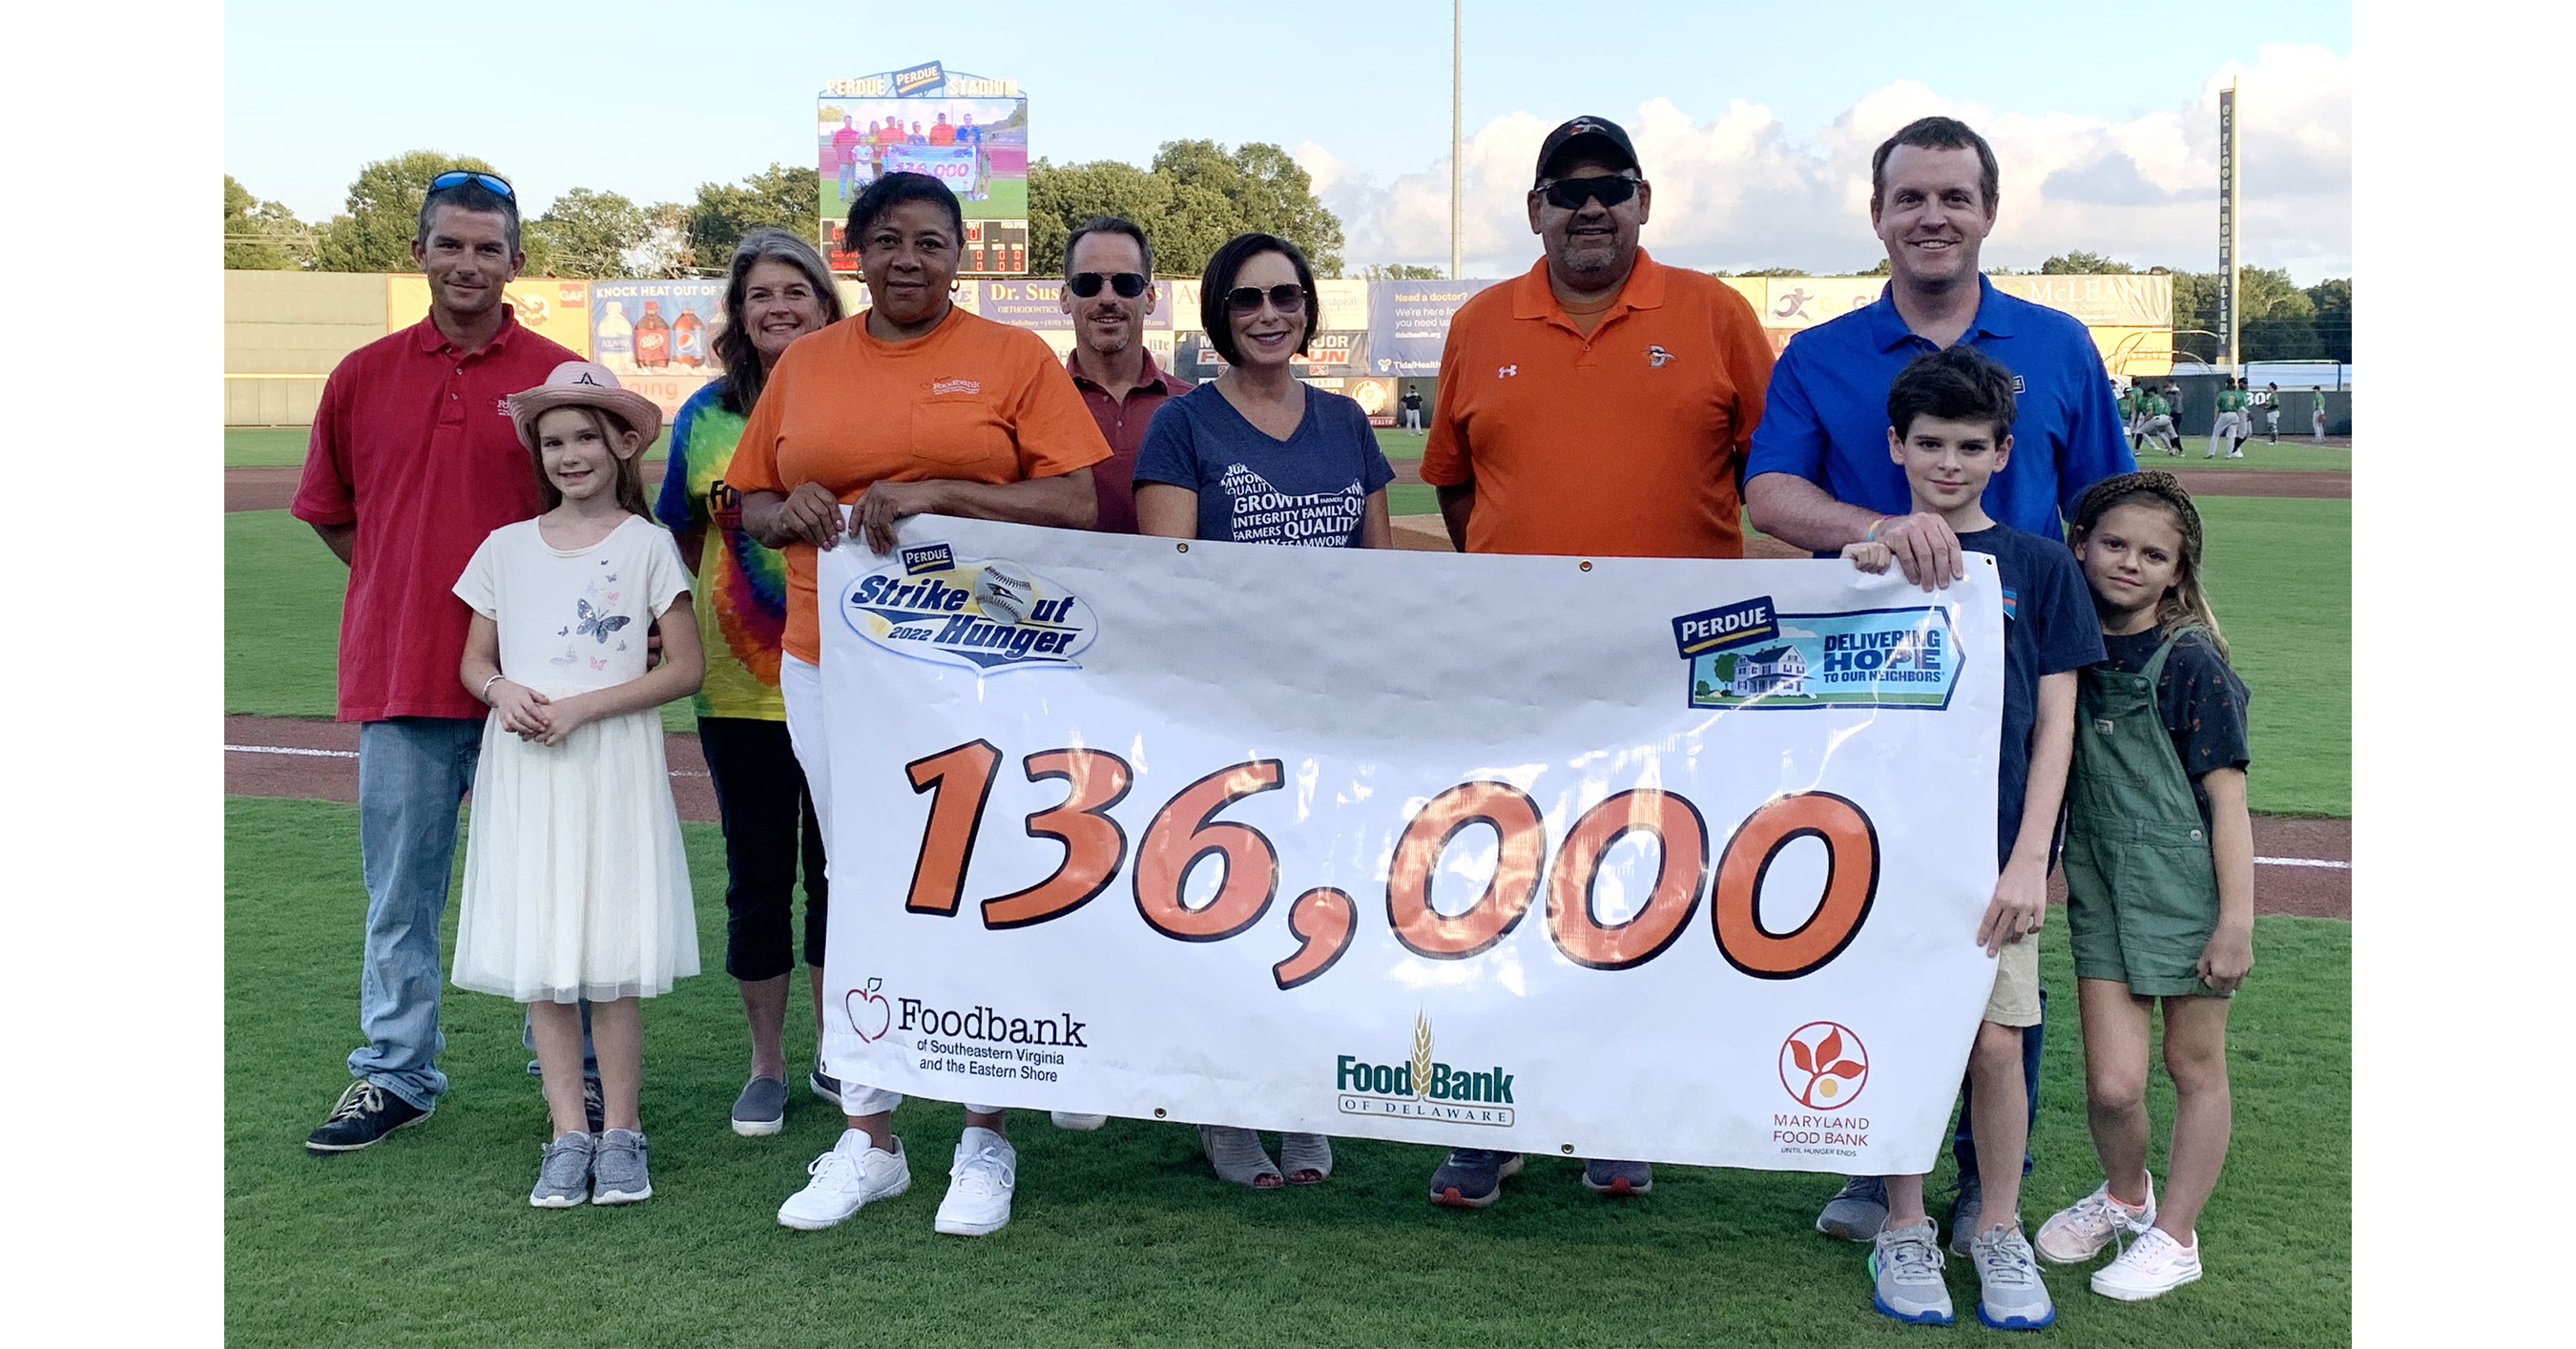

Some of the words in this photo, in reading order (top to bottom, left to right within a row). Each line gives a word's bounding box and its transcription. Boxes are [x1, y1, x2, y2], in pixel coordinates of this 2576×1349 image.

[896, 66, 940, 86] PERDUE
[826, 79, 886, 95] PERDUE
[948, 79, 1019, 95] STADIUM
[2221, 104, 2231, 126] OC
[559, 290, 585, 301] GAF
[596, 286, 638, 299] KNOCK
[641, 286, 670, 297] HEAT
[674, 286, 697, 296] OUT
[701, 286, 717, 296] OF
[990, 283, 1022, 301] Dr.
[1026, 283, 1060, 301] Sus
[1395, 293, 1421, 302] Need
[1430, 293, 1468, 301] doctor?
[2029, 280, 2143, 301] McLEAN
[997, 305, 1059, 314] ORTHODONTICS
[1319, 296, 1365, 311] esapeake
[1395, 307, 1422, 317] We're
[1423, 306, 1444, 317] here
[1446, 306, 1457, 316] fo
[2219, 264, 2229, 344] GALLERY
[1395, 320, 1412, 330] you
[1414, 318, 1438, 327] need
[1312, 335, 1349, 348] JOR
[1394, 360, 1442, 369] TidalHealth
[1235, 492, 1319, 513] GROWTH
[1234, 509, 1298, 529] INTEGRITY
[1301, 505, 1344, 520] FAMILY
[1234, 526, 1281, 541] FARMERS
[1284, 516, 1359, 539] QUALITY
[1280, 535, 1348, 548] EAMWORK
[905, 549, 949, 564] PERDUE
[851, 574, 969, 612] Strike
[1682, 606, 1769, 641] PERDUE
[887, 626, 933, 640] 2022
[933, 612, 1076, 659] Hunger
[1824, 630, 1941, 652] DELIVERING
[1824, 649, 1941, 673] HOPE
[1823, 672, 1839, 684] TO
[1841, 672, 1866, 683] OUR
[1869, 671, 1942, 683] NEIGHBORS
[905, 737, 1880, 989] 136,000
[898, 997, 1088, 1048] Foodbank
[917, 1038, 928, 1051] of
[931, 1040, 1013, 1060] Southeastern
[1016, 1048, 1065, 1066] Virginia
[920, 1057, 943, 1071] and
[946, 1059, 966, 1072] the
[969, 1061, 1017, 1079] Eastern
[1020, 1066, 1058, 1083] Shore
[1337, 1054, 1414, 1096] Food
[1429, 1062, 1514, 1104] Bank
[1344, 1100, 1370, 1110] OF
[1385, 1103, 1506, 1123] DELAWARE
[1774, 1113, 1870, 1130] MARYLAND
[1773, 1131, 1820, 1144] FOOD
[1824, 1131, 1869, 1147] BANK
[1836, 1149, 1857, 1157] ENDS
